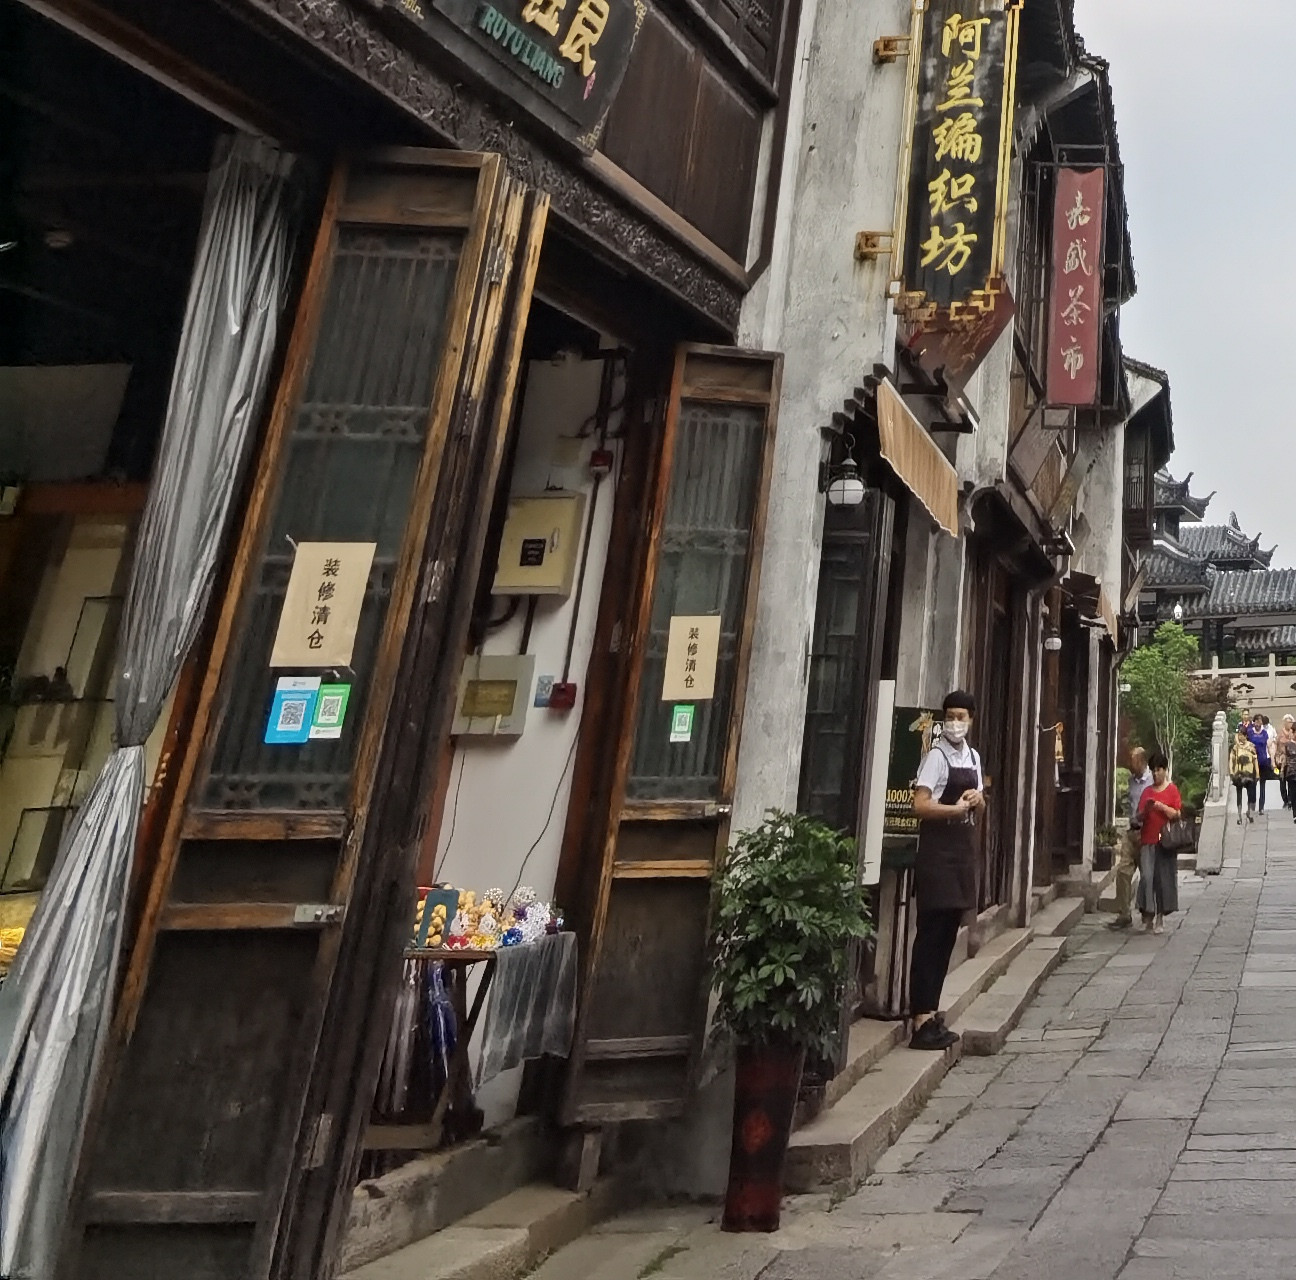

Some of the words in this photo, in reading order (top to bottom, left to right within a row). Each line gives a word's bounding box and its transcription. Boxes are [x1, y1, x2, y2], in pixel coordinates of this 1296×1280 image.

[307, 558, 341, 649] 装修清仓
[684, 627, 699, 689] 装修清仓
